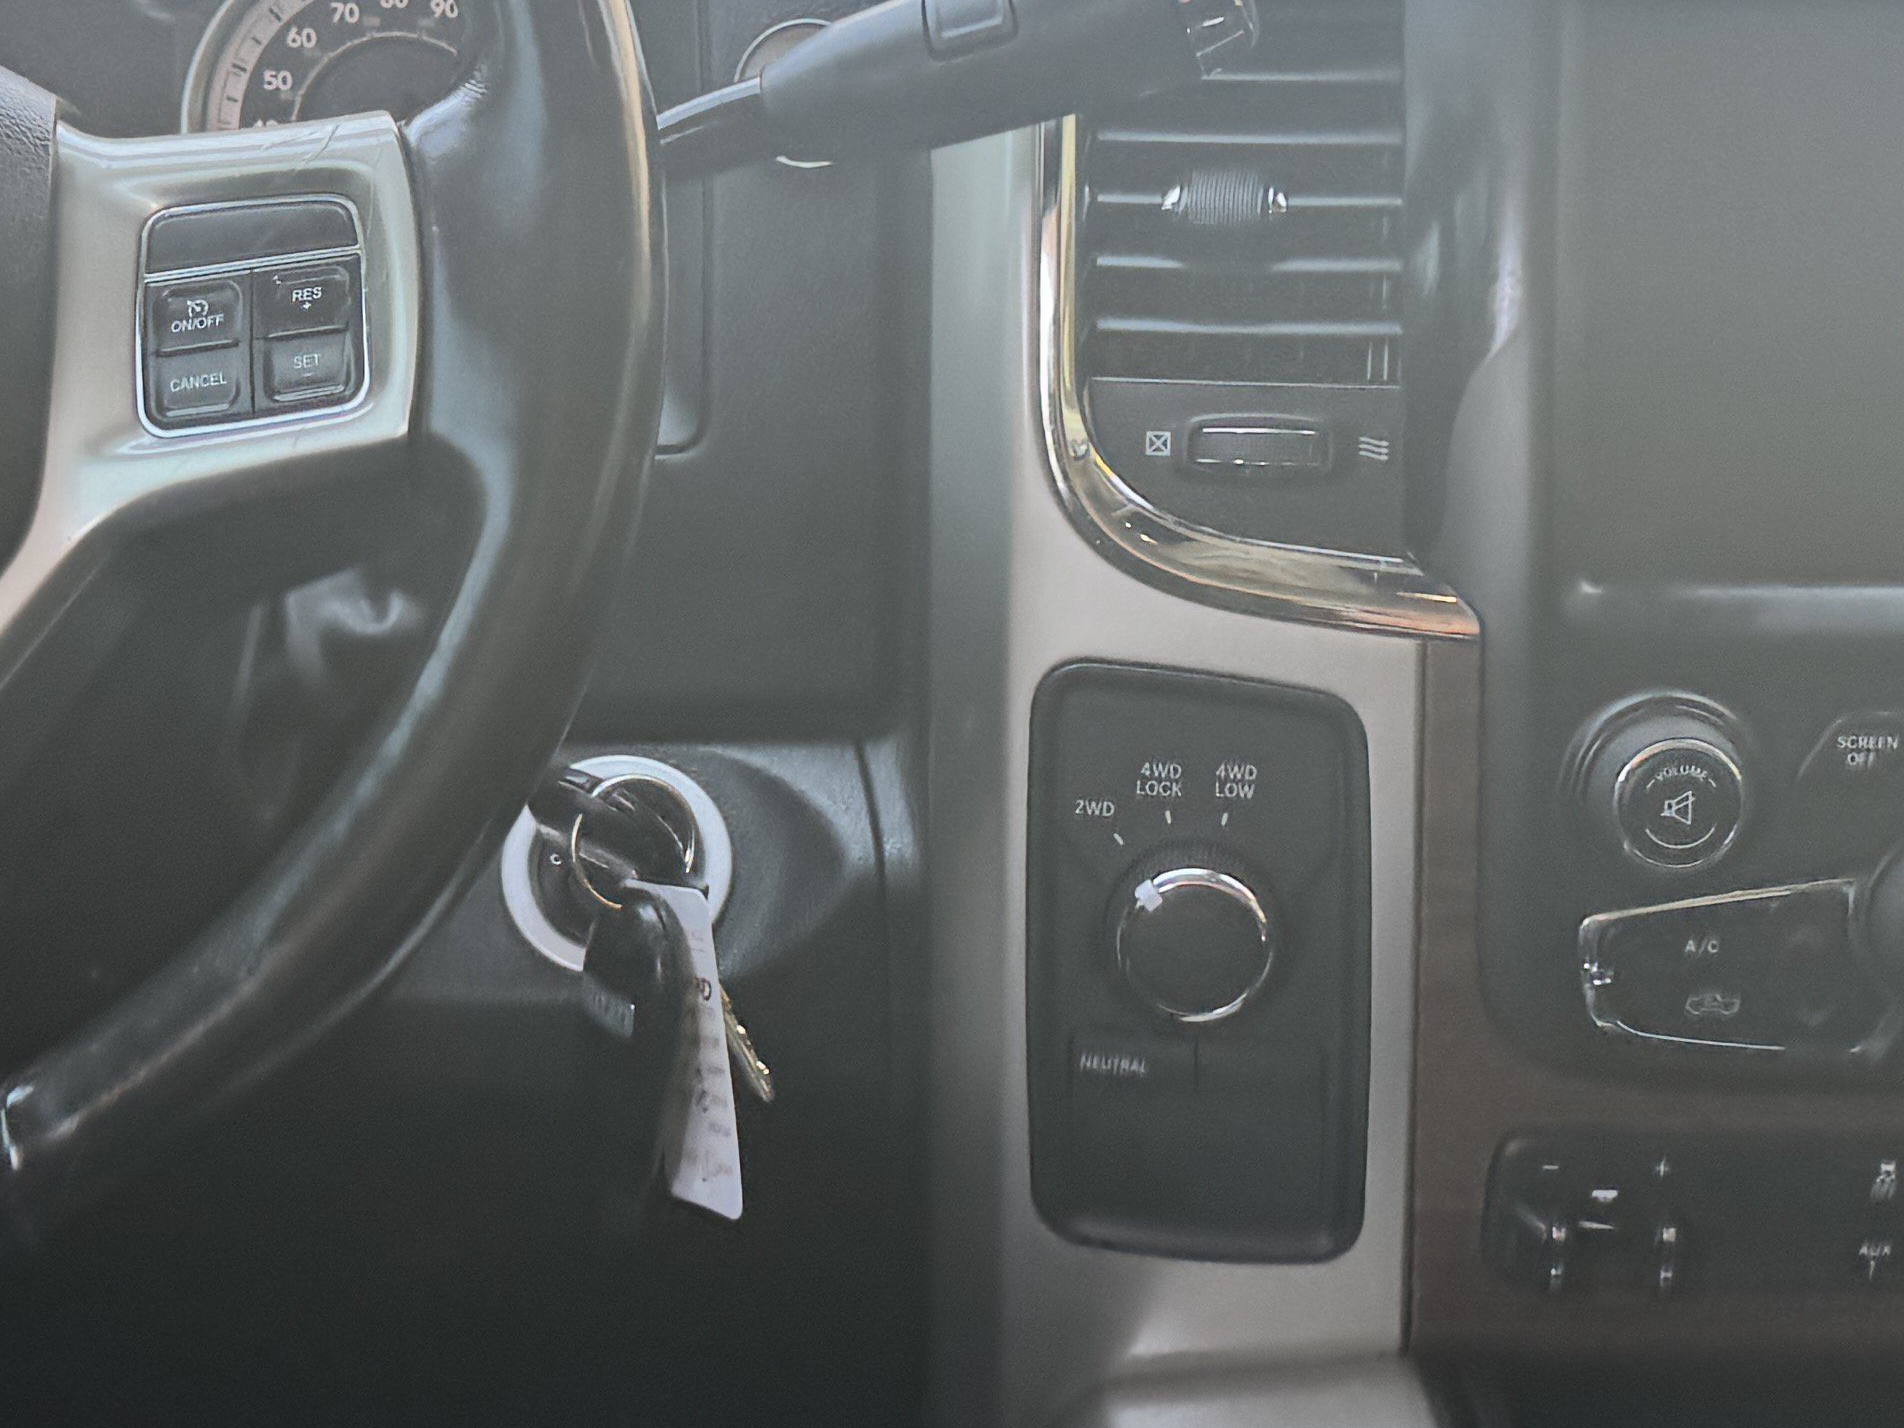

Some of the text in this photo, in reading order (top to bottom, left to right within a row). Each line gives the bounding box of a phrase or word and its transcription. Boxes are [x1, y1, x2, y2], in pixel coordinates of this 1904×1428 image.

[329, 2, 360, 23] 70
[286, 27, 317, 48] 60
[263, 71, 293, 90] 50
[292, 286, 322, 303] RES
[171, 314, 224, 333] ON/OFF
[293, 354, 321, 369] SET
[170, 372, 227, 392] CANCEL
[1837, 734, 1899, 750] SCREEN
[1847, 752, 1877, 768] OFF
[1141, 762, 1182, 779] 4WD
[1215, 764, 1258, 781] 4WD
[1655, 764, 1709, 782] VOLUME
[1136, 780, 1182, 797] LOCK
[1215, 782, 1255, 799] LOW
[1074, 799, 1115, 817] 2WD
[1684, 939, 1719, 954] A/C
[1080, 1053, 1146, 1076] NEUTRAL
